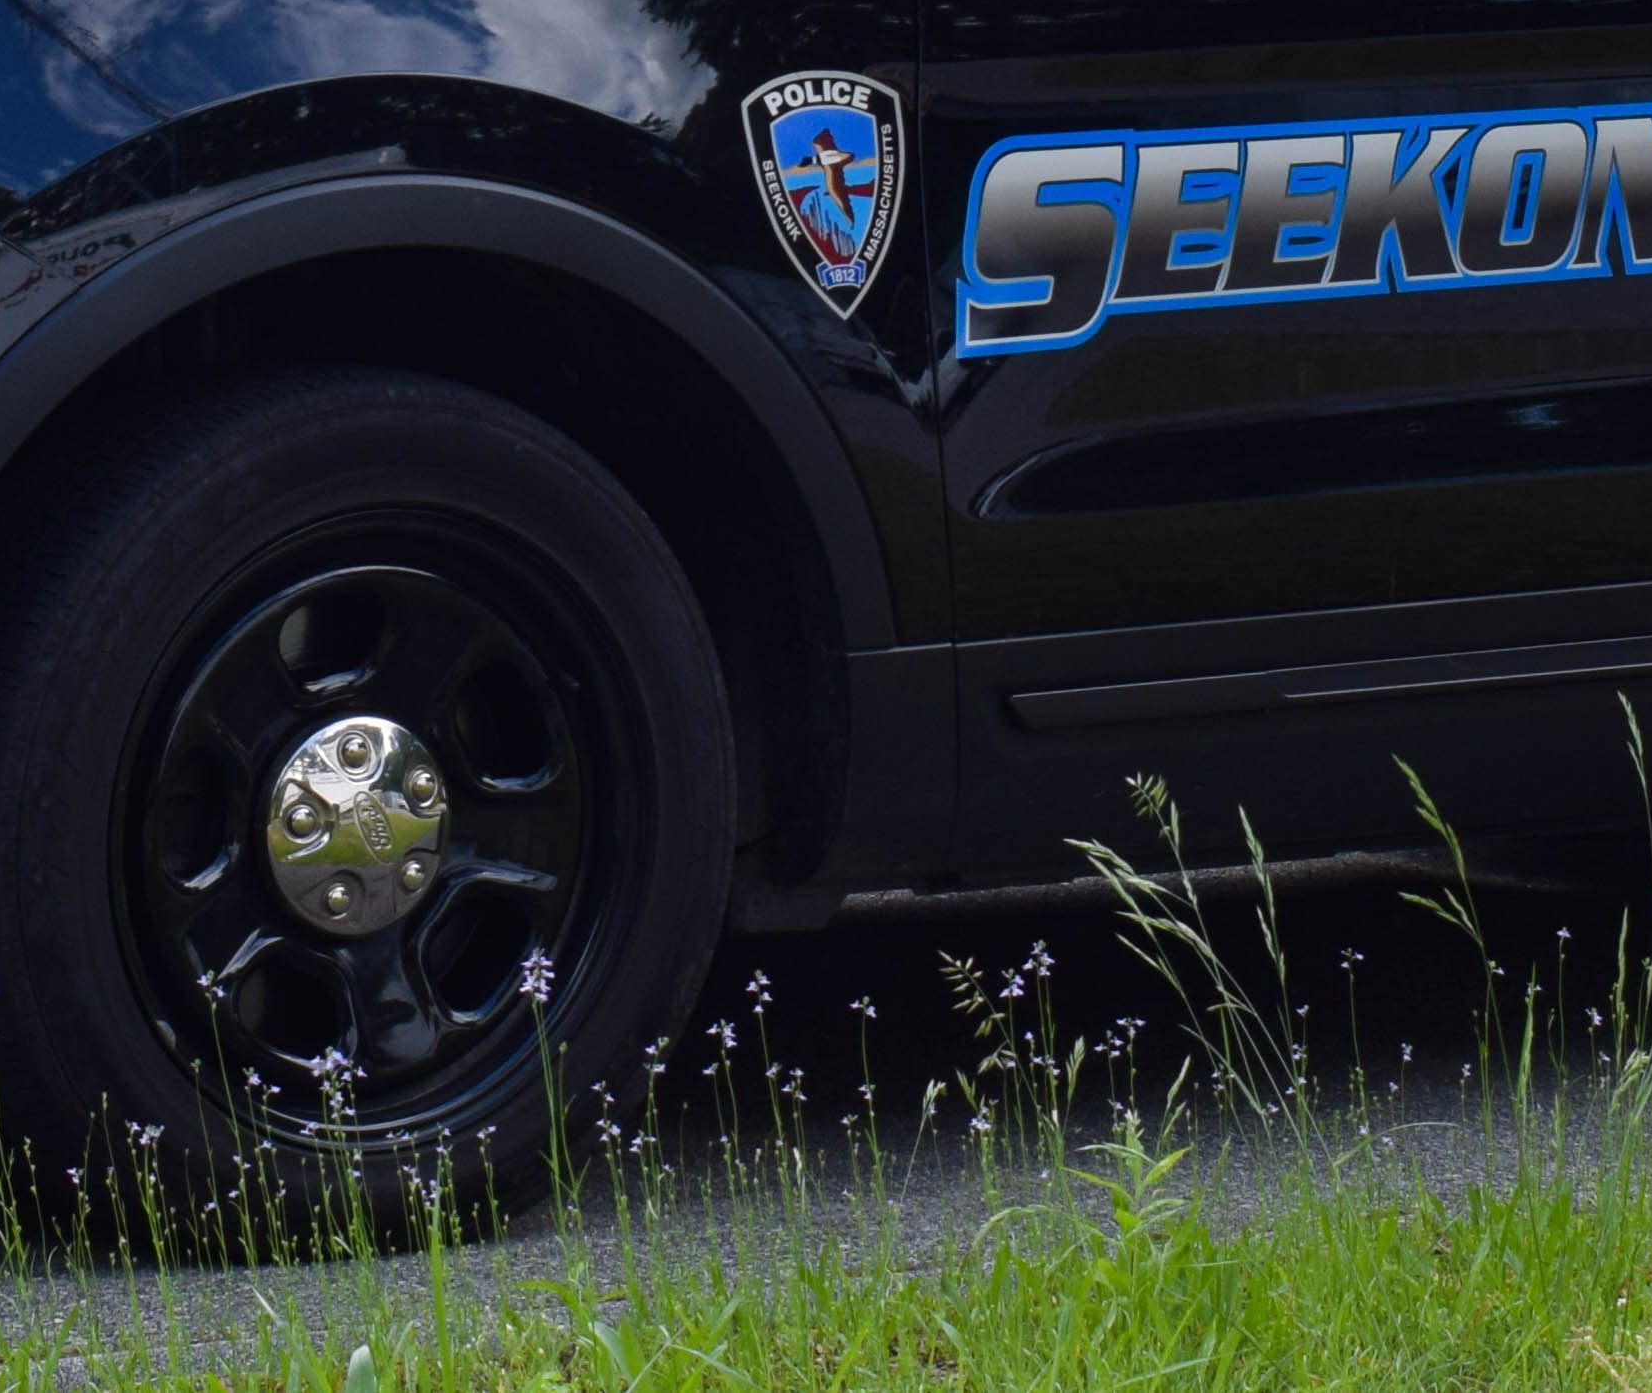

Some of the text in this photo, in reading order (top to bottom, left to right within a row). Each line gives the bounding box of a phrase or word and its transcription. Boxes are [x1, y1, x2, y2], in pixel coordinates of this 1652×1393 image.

[763, 79, 872, 117] POLICE
[762, 159, 801, 242] SEEKONK
[863, 123, 893, 262] MASSACHUSETTS
[828, 267, 856, 284] 1812
